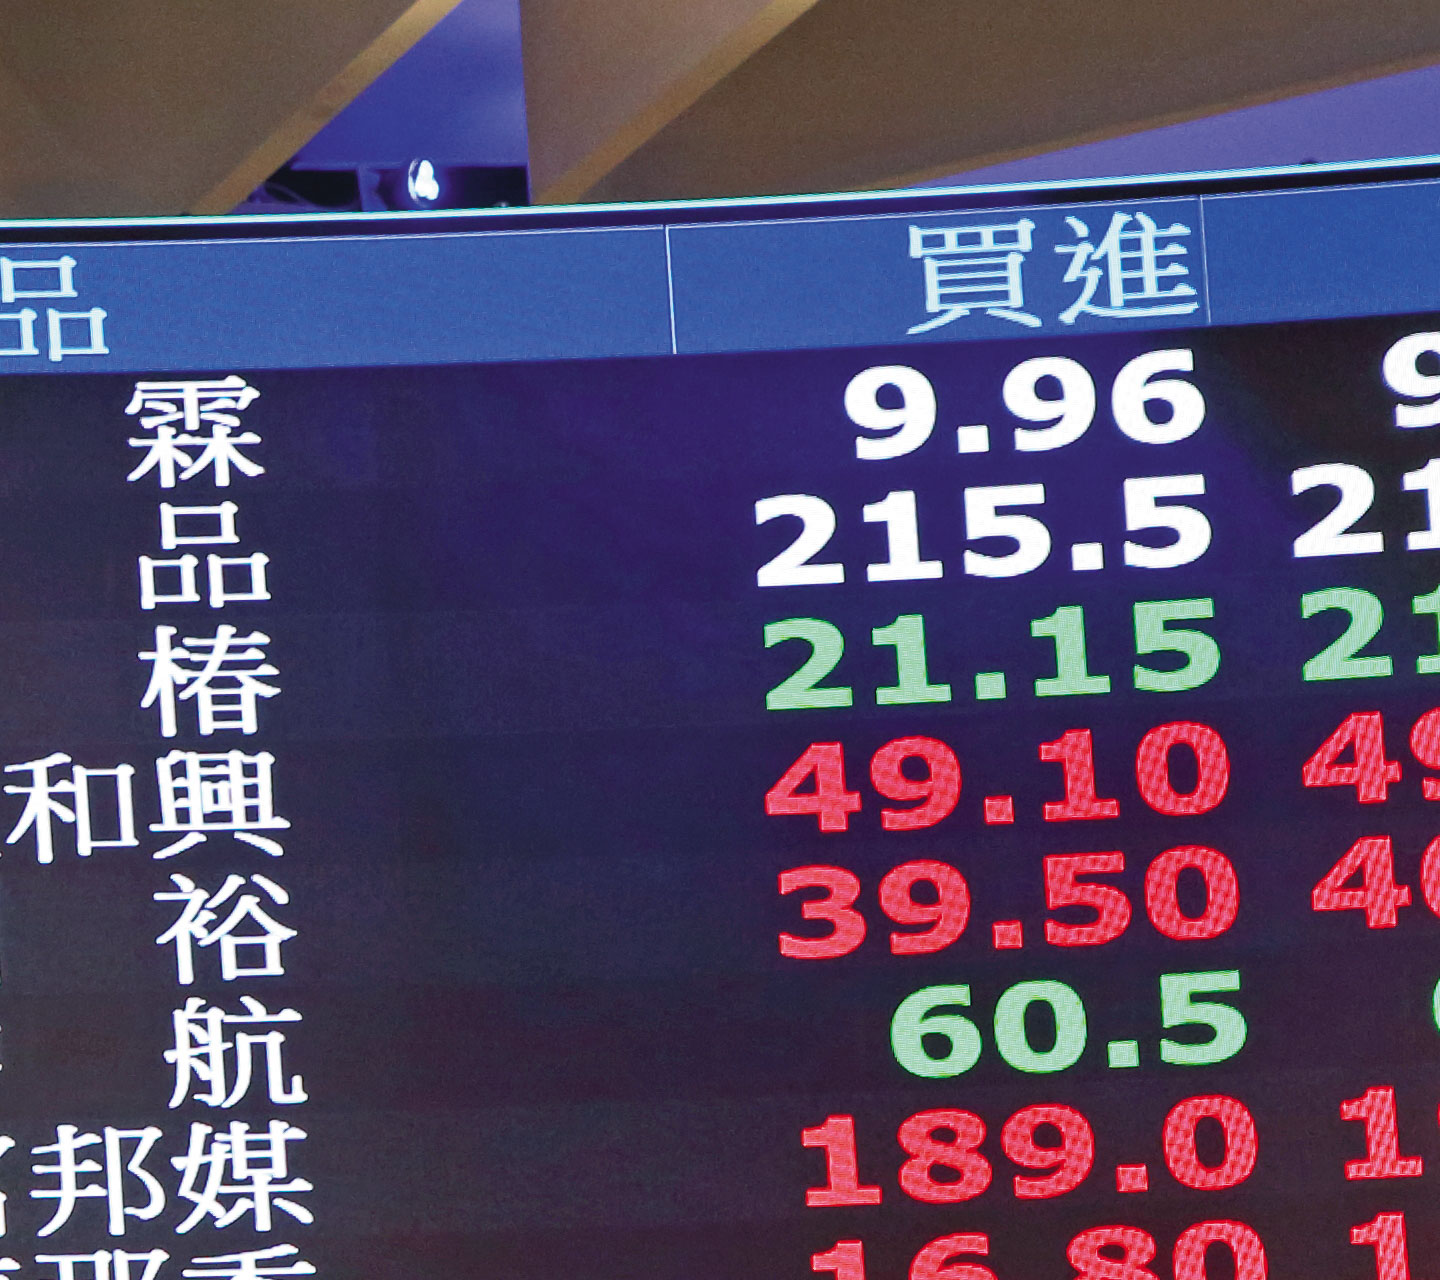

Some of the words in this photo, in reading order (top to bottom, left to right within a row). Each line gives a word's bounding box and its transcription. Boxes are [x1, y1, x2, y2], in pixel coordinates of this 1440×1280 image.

[908, 207, 1198, 334] 買進
[125, 375, 265, 488] 霖
[844, 349, 1205, 460] 9.96
[139, 501, 271, 609] 品
[755, 474, 1211, 587] 215.5
[764, 598, 1220, 710] 21.15
[765, 721, 1230, 833] 49.10
[778, 845, 1240, 959] 39.50
[891, 970, 1247, 1078] 60.5
[801, 1094, 1258, 1207] 189.0
